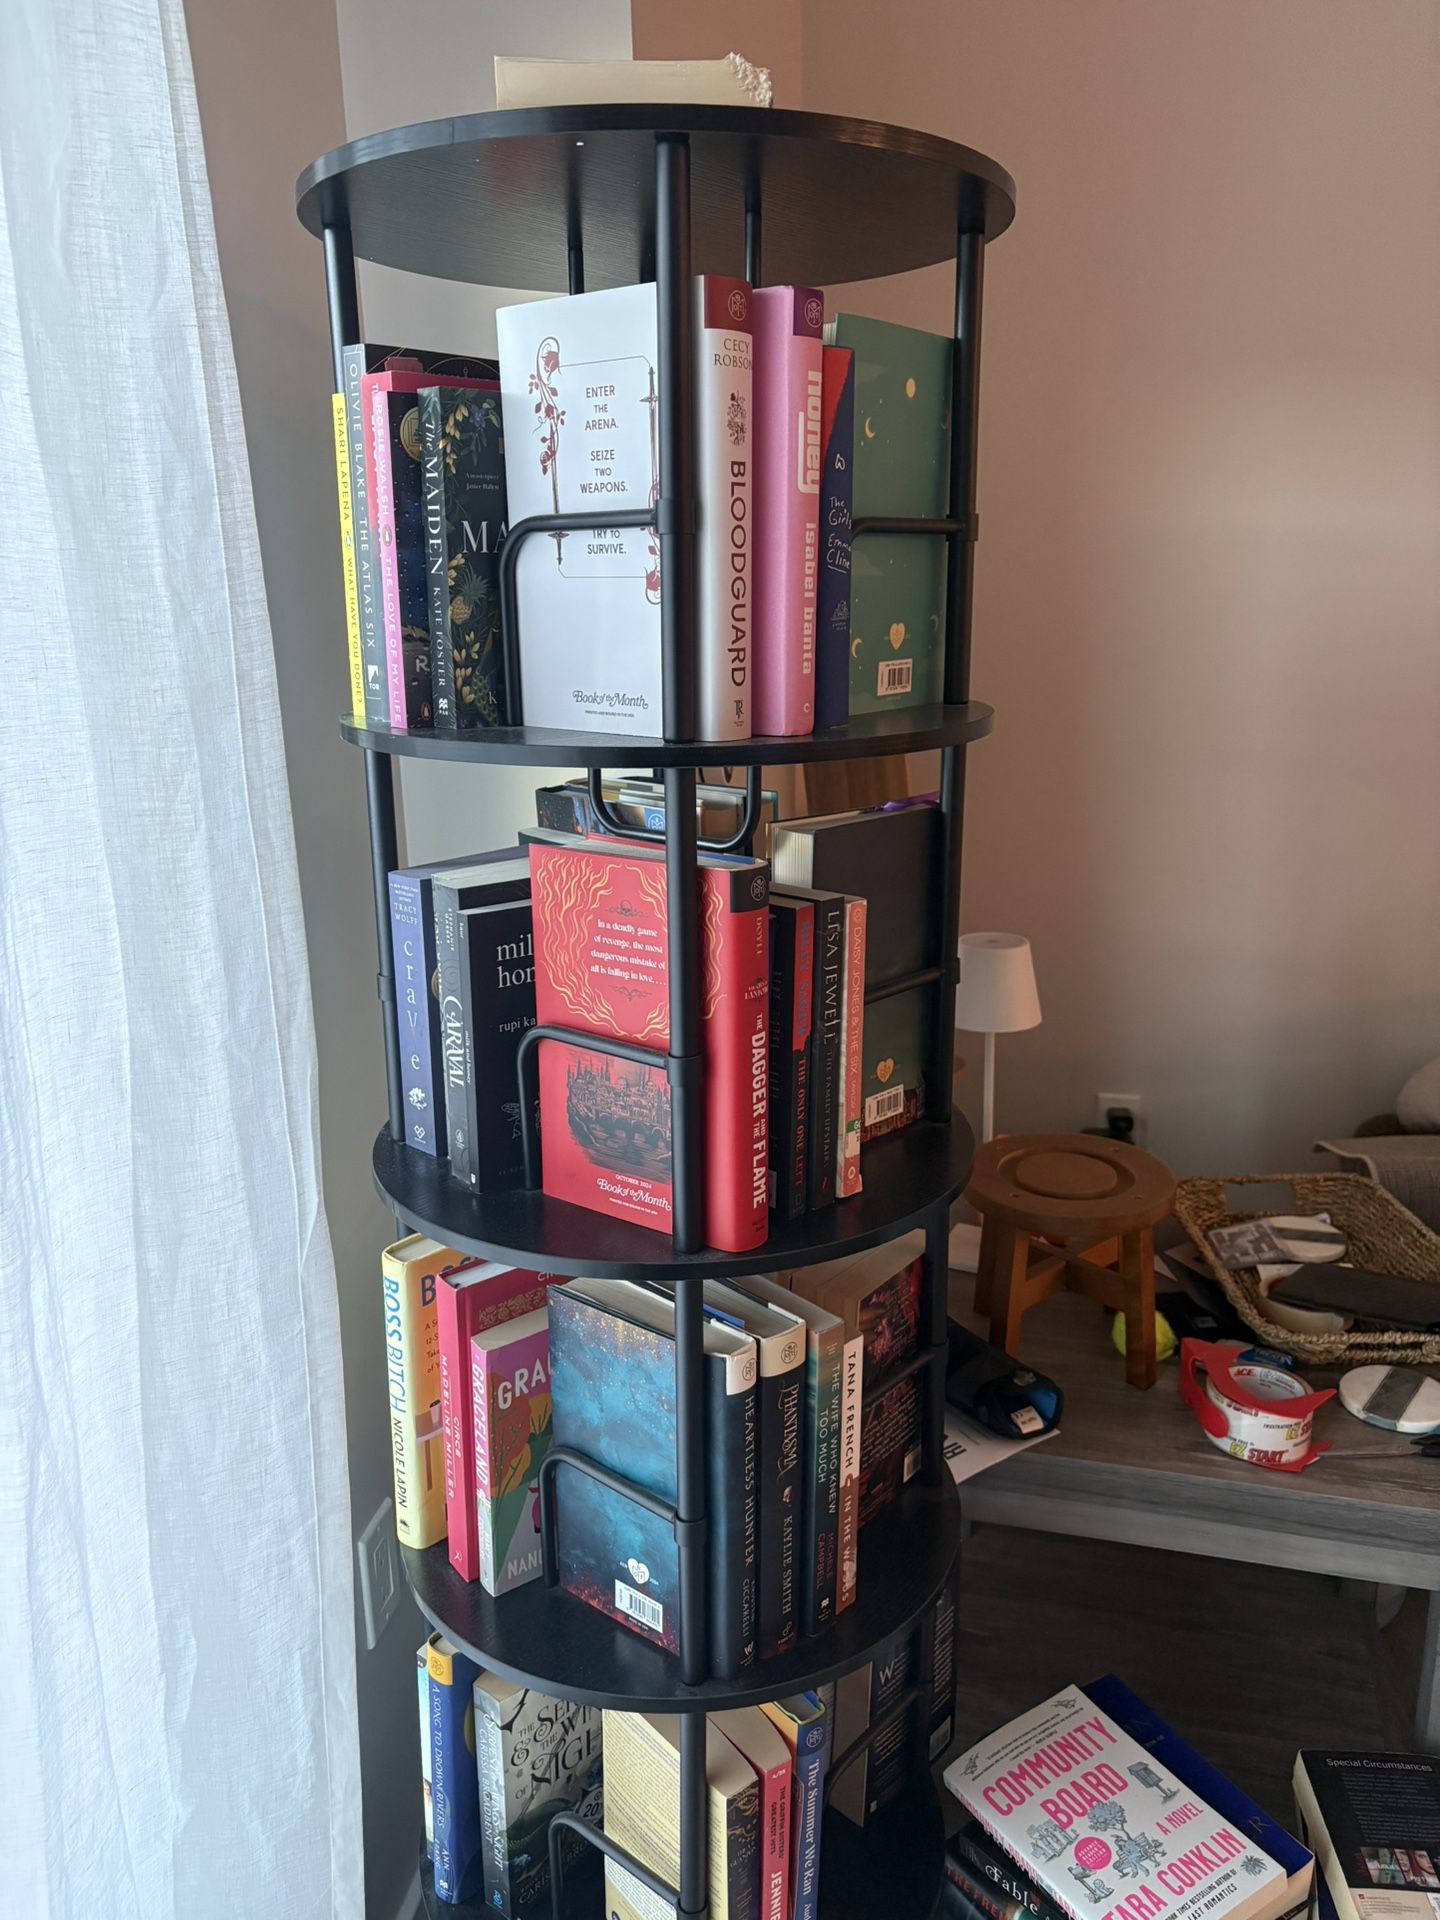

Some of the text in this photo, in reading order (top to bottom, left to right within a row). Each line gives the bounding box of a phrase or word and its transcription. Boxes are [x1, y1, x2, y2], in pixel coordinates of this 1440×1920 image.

[723, 338, 750, 353] CECY
[586, 385, 615, 398] ENTER
[594, 404, 608, 413] THE
[336, 407, 346, 452] SHARI
[585, 418, 619, 430] ARENA.
[590, 450, 615, 462] SEIZE
[595, 468, 612, 476] TWO
[340, 460, 350, 522] LAPENA
[350, 362, 375, 648] OLIVIE BLAKE THE ATLAS SIX
[580, 481, 628, 494] WEAPONS.
[830, 496, 845, 507] The
[592, 528, 620, 539] TRY TO
[829, 510, 852, 528] Girls
[425, 422, 446, 687] The MAIDEN KATE FOSTER
[587, 544, 627, 555] SURVIVE.
[826, 550, 850, 568] Cline
[828, 533, 851, 552] Emma
[375, 404, 401, 722] ROSIE WALSH THE LOVE OF MY LIFE
[728, 461, 746, 687] BLOODGUARD
[593, 934, 663, 954] of revenge, the most
[597, 919, 657, 937] In a deadly game
[827, 911, 840, 958] LISA
[853, 927, 862, 965] DAISY
[591, 950, 666, 969] dangerous mistake of
[607, 967, 630, 980] falling
[631, 971, 638, 980] in
[852, 969, 860, 1013] JONES
[500, 1018, 521, 1033] rupi
[851, 1017, 859, 1027] &
[443, 996, 465, 1088] CARAVAL
[752, 1031, 766, 1117] DAGGER
[850, 1056, 858, 1073] SIX
[796, 1088, 807, 1120] ONLY
[796, 1124, 804, 1151] ONE
[616, 1174, 638, 1185] OCTOBER
[753, 1139, 766, 1208] FLAME
[597, 1178, 626, 1196] Book
[633, 1189, 671, 1211] Month
[847, 1352, 856, 1398] TANA
[1234, 1368, 1255, 1376] ACE
[384, 1276, 408, 1508] BOSS BITCH NICOLE LAPIN
[440, 1355, 454, 1498] MADELINE MILLER
[453, 1417, 461, 1458] CIRCE
[471, 1364, 488, 1485] GRACELAND
[828, 1364, 840, 1514] THE WIFE WHO KNEW
[845, 1405, 855, 1469] FRENCH
[818, 1410, 828, 1483] TOO MUCH
[1248, 1448, 1285, 1463] START
[745, 1395, 755, 1567] HEARTLESS HUNTER
[778, 1381, 799, 1615] PHANTASMA KAYLIE SMITH
[844, 1496, 851, 1512] IN
[817, 1533, 825, 1590] CAMPBELL
[432, 1684, 445, 1829] A SONG TO DROWN RIVERS
[982, 1716, 1118, 1817] COMMUNITY
[1326, 1758, 1433, 1772] Special Circumstances
[480, 1728, 494, 1844] CARISSA BROADBENT
[1040, 1762, 1128, 1830] BOARD
[803, 1759, 820, 1896] The Summer We Ran
[1155, 1802, 1204, 1836] A NOVEL
[442, 1848, 450, 1871] ANN
[1155, 1828, 1247, 1897] CONKLIN
[986, 1865, 1038, 1915] Fable
[1177, 1868, 1237, 1915] TIMES BESTSELLING AUTHOR OF
[1203, 1883, 1238, 1910] ROMANTICS
